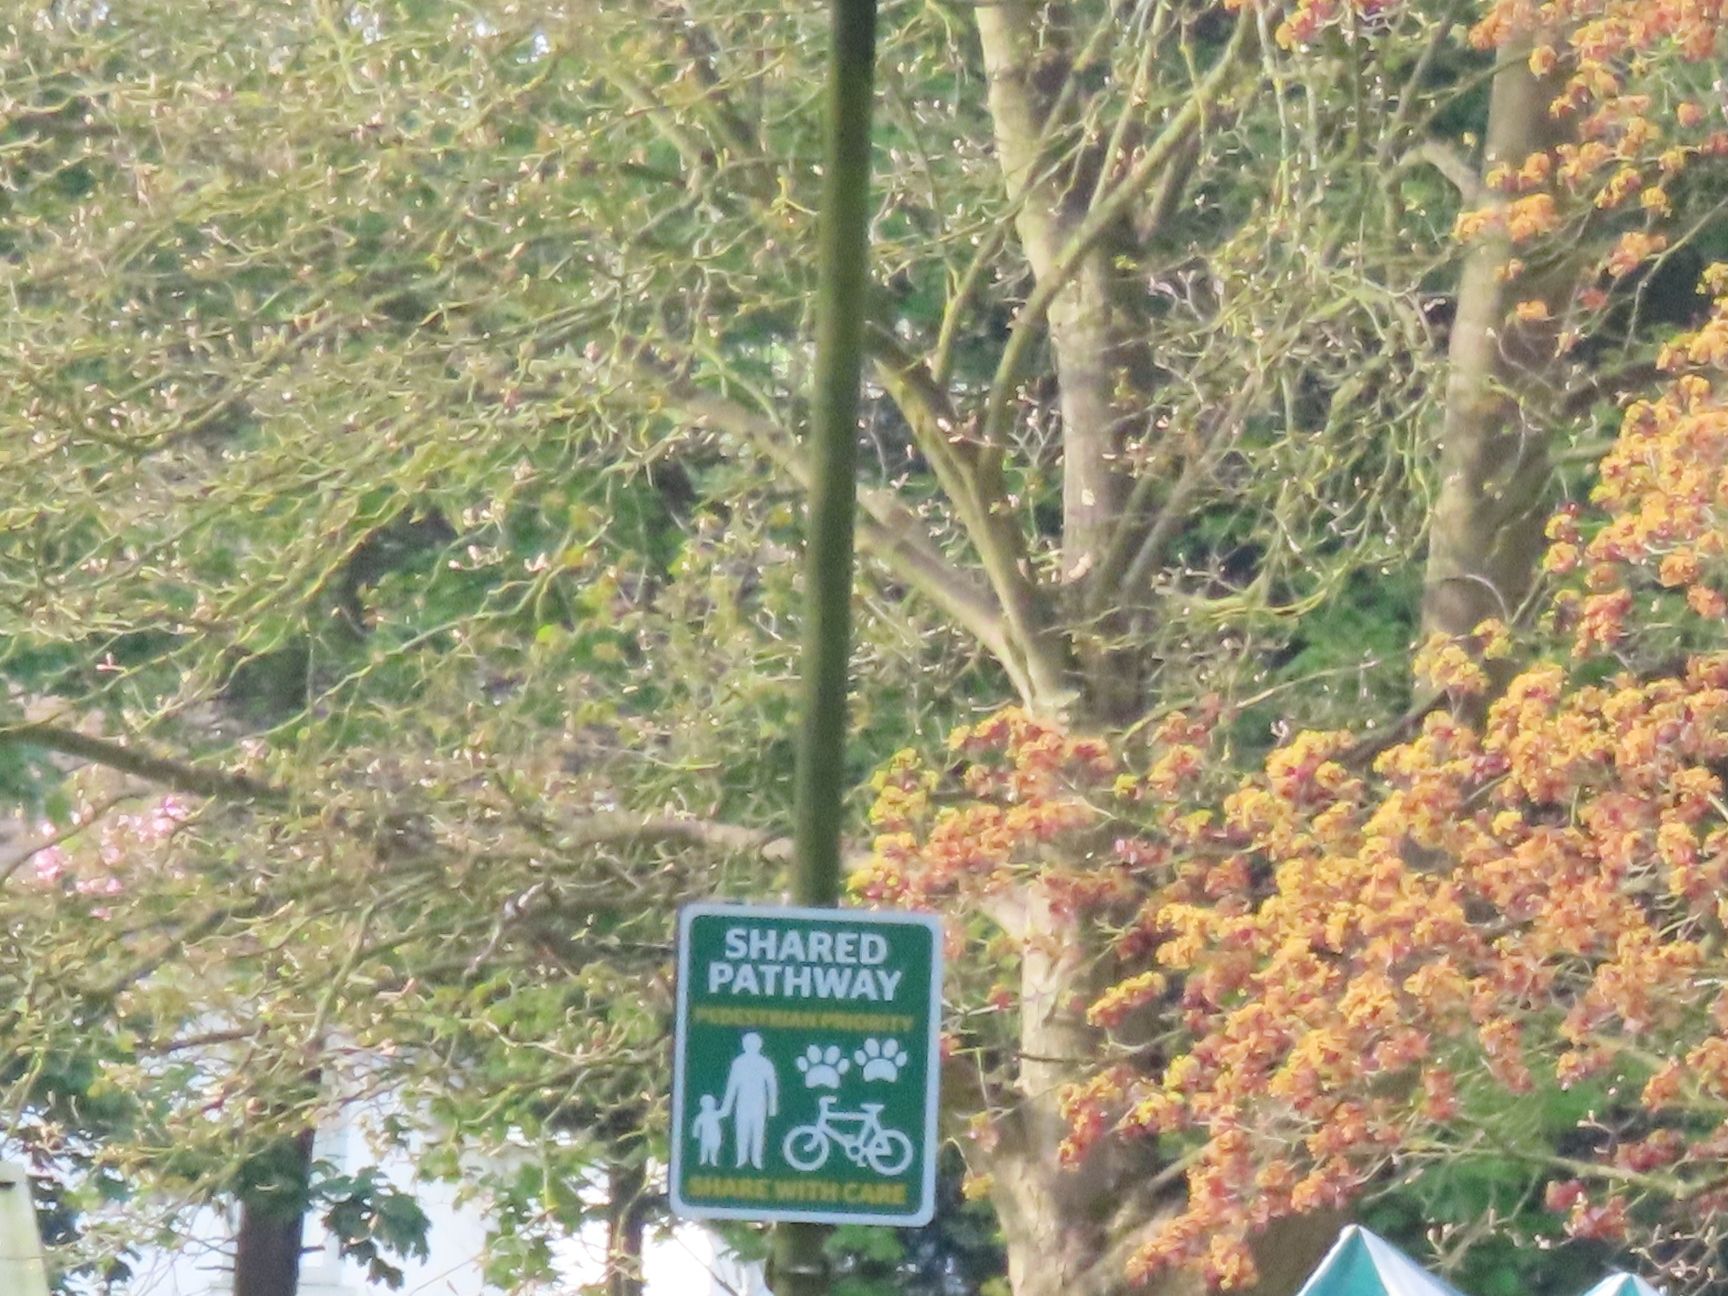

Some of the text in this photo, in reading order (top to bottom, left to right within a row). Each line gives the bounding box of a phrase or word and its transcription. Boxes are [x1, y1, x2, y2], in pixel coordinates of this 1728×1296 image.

[724, 927, 888, 966] SHARED
[708, 961, 902, 1001] PATHWAY
[688, 1174, 907, 1206] SHARE WITH CARE
